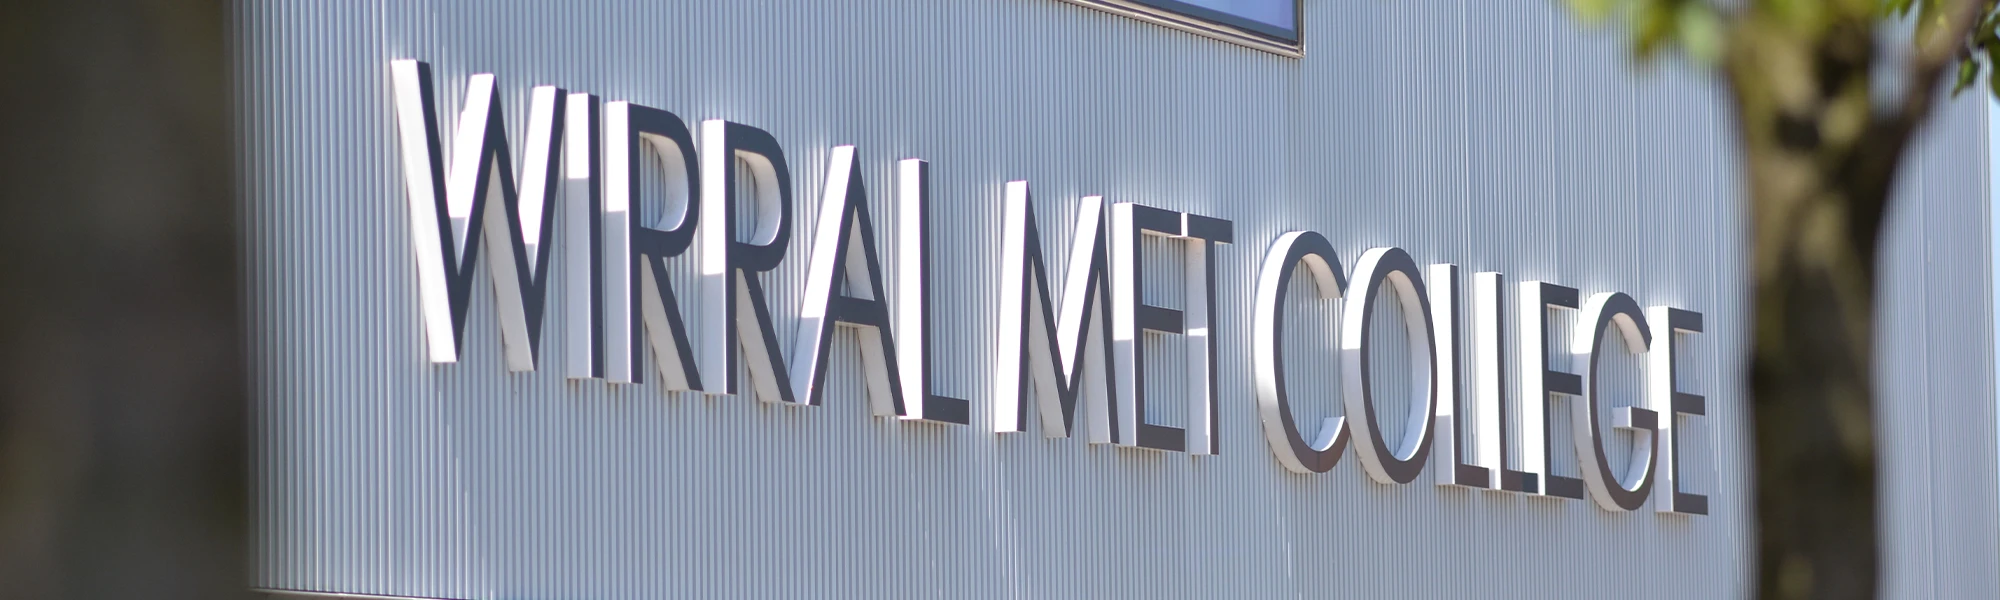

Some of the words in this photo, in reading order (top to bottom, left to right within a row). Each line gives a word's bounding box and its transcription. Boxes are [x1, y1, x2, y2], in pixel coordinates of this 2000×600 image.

[391, 59, 969, 425] WIRRAL
[995, 180, 1233, 456] MET
[1256, 230, 1708, 515] COLLEGE
